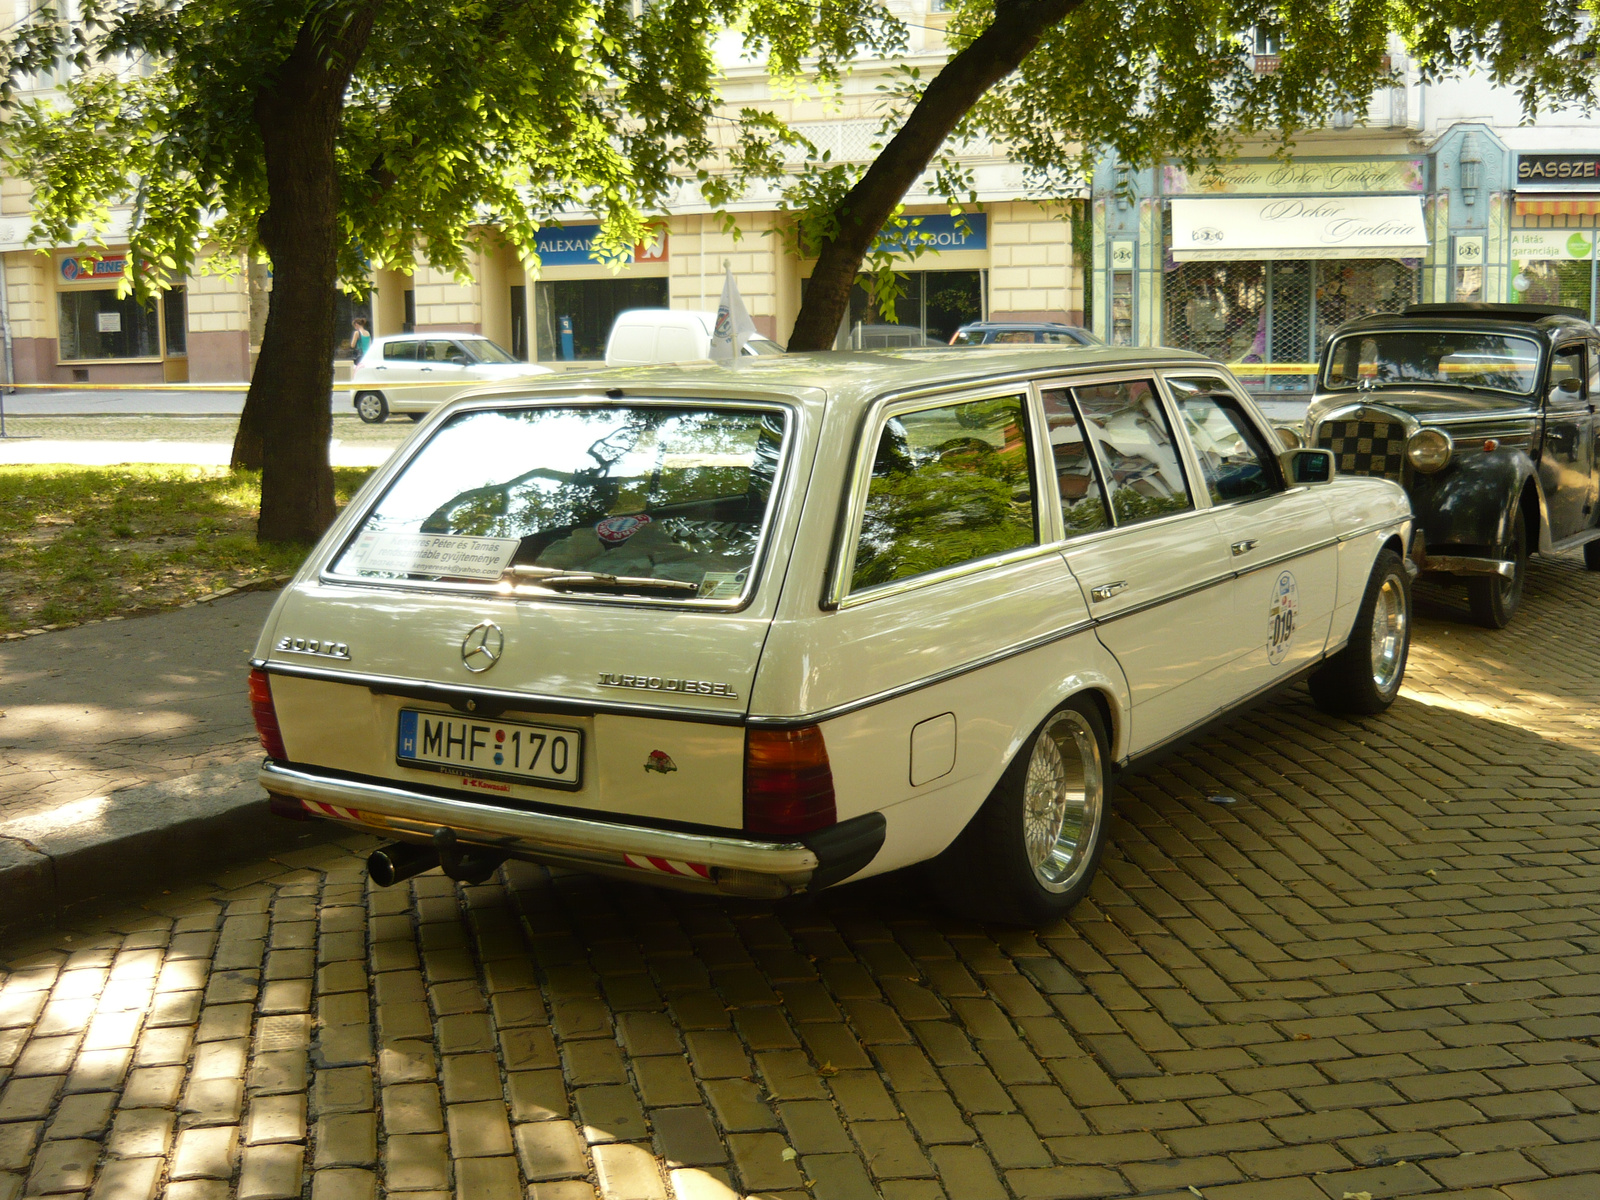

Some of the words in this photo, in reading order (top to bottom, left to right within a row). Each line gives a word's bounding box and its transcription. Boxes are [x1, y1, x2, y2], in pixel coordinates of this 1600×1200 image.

[1266, 166, 1323, 187] Dekor
[1259, 199, 1346, 222] Dekor
[1320, 218, 1416, 244] Galéria
[1512, 236, 1519, 244] A
[1522, 235, 1544, 244] látás
[1512, 246, 1560, 257] garanciája
[432, 538, 456, 549] Péter
[457, 540, 468, 550] és
[471, 541, 500, 552] Tamás
[440, 551, 500, 566] gyűjteménye
[412, 562, 499, 575] kenyeresek@yahoo.com
[1272, 609, 1292, 647] 019
[404, 738, 413, 751] H
[478, 781, 511, 793] Kawasaki
